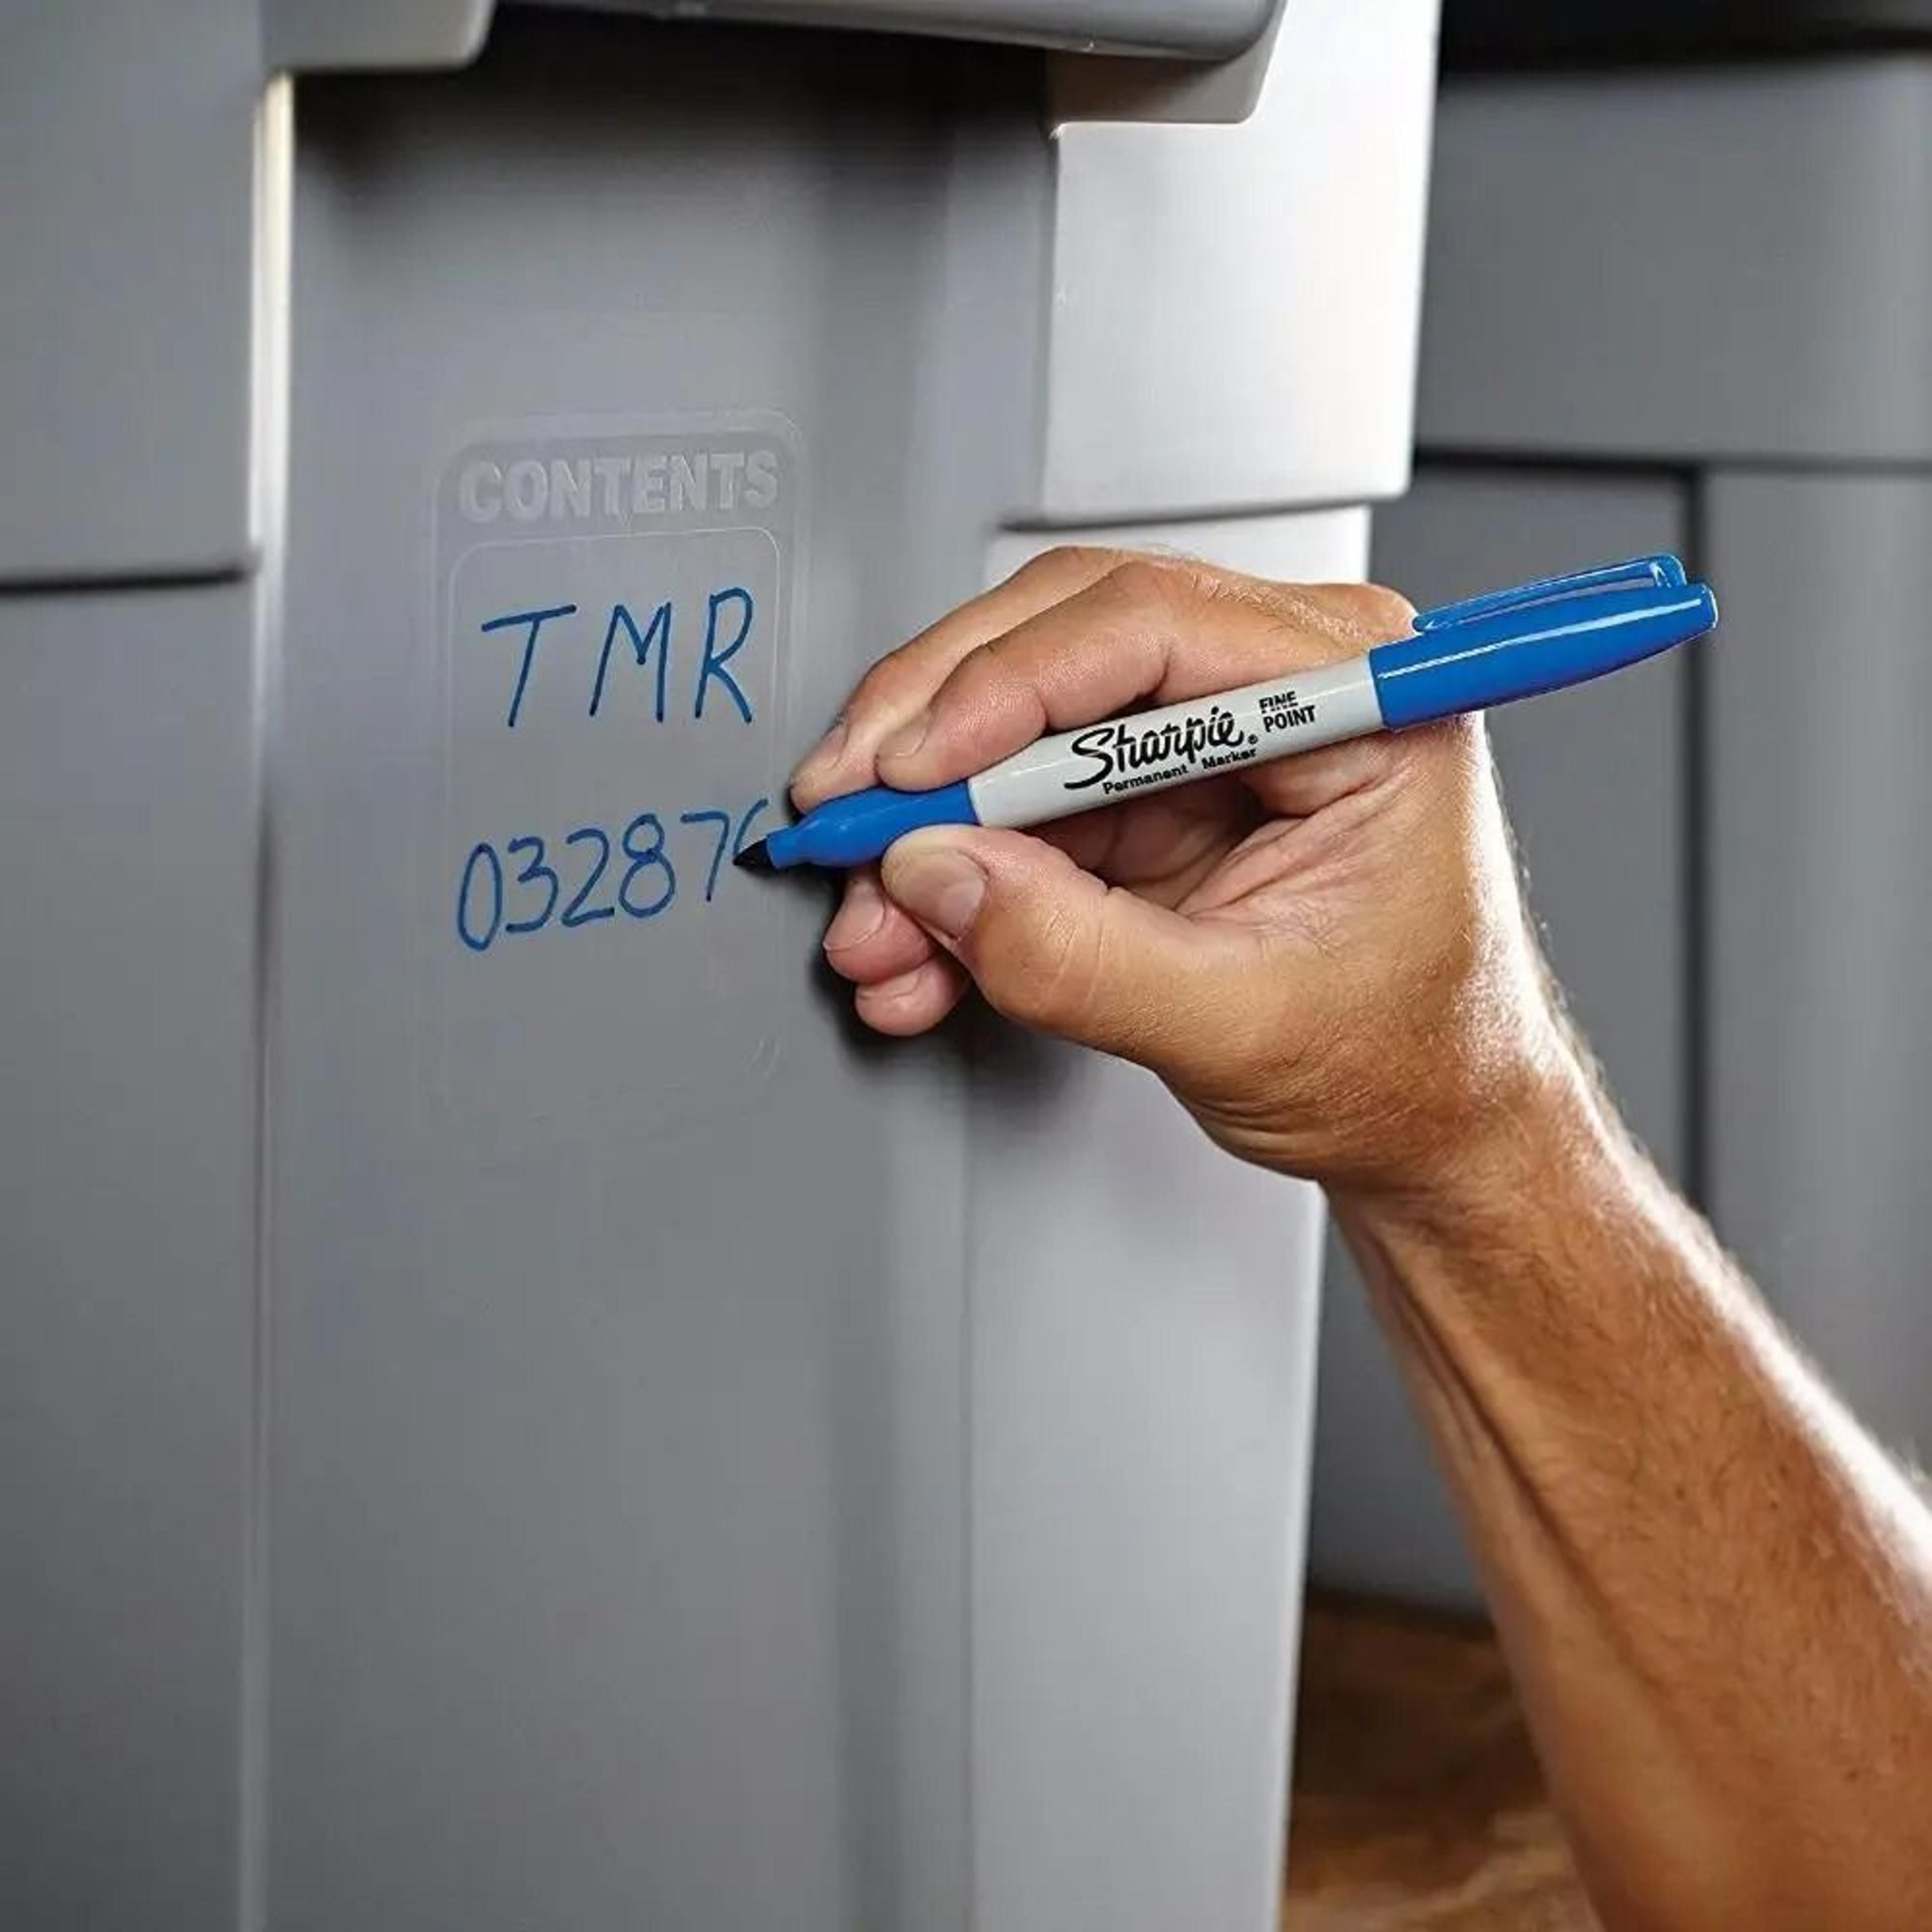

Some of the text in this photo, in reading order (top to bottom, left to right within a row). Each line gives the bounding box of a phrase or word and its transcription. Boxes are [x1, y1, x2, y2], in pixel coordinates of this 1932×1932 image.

[460, 450, 779, 523] CONTENTS
[481, 587, 754, 728] TMR
[1259, 691, 1298, 713] FINE
[1264, 705, 1316, 733] POINT
[1064, 706, 1245, 790] Sharpie
[1103, 748, 1258, 794] Permanent Marker
